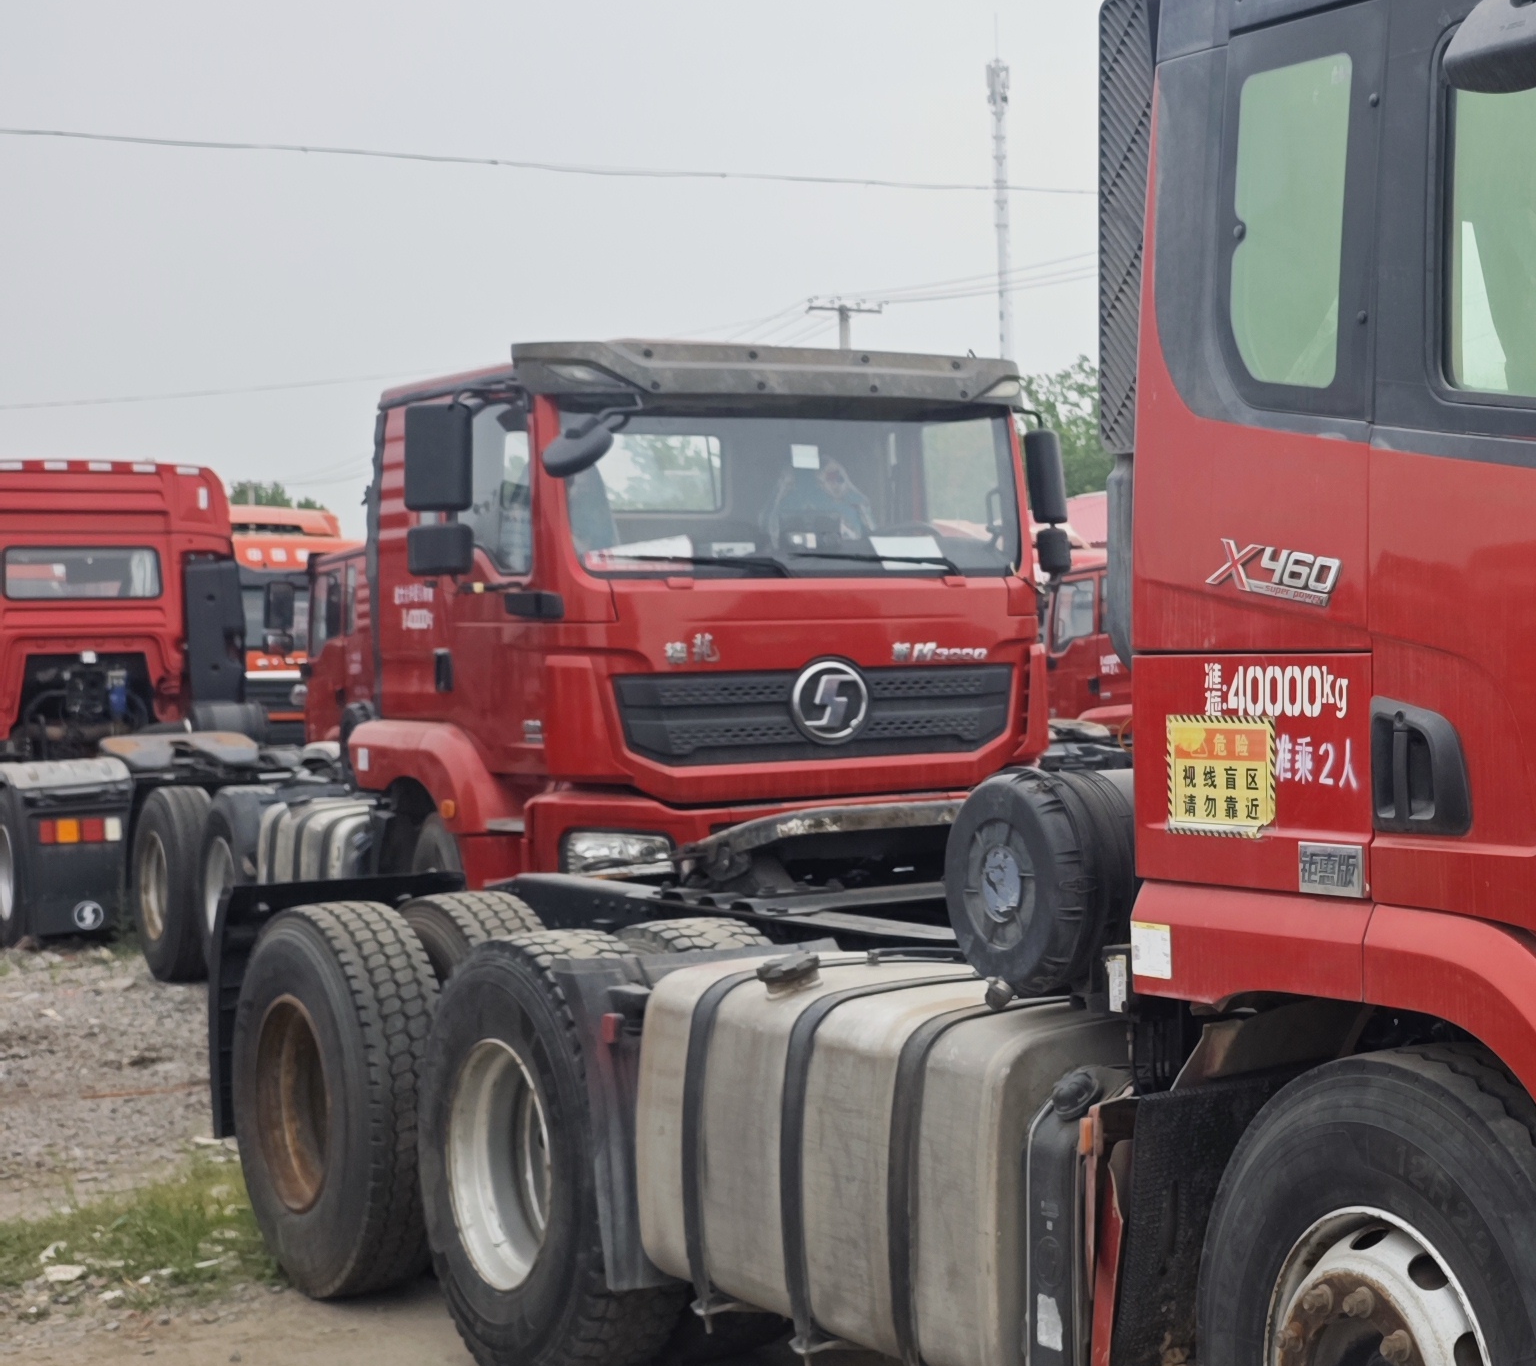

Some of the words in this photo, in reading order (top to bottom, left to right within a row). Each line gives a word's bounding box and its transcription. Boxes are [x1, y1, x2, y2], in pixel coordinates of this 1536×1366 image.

[1204, 537, 1342, 593] X460
[1264, 584, 1290, 596] super
[1292, 590, 1325, 605] power
[1213, 733, 1250, 757] 危险
[1275, 733, 1359, 790] 准乘2人
[1182, 765, 1260, 791] 视线盲区
[1182, 793, 1261, 821] 请勿靠近
